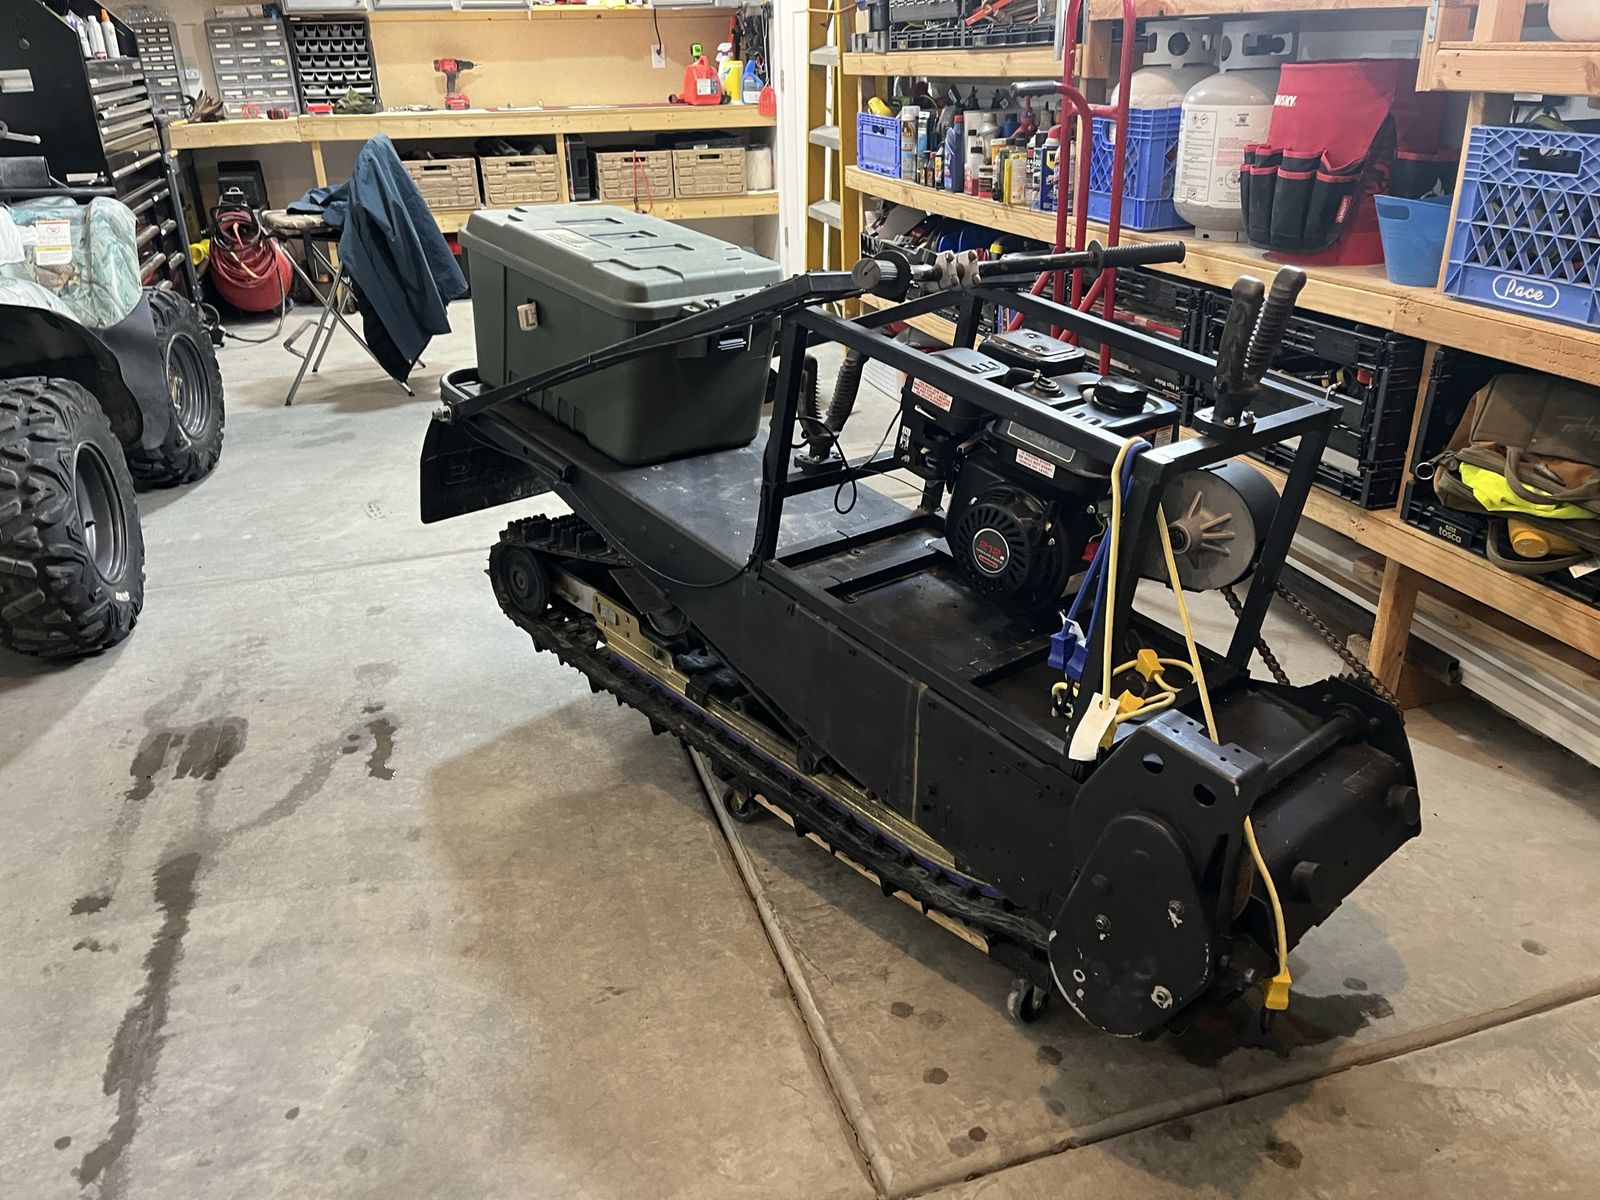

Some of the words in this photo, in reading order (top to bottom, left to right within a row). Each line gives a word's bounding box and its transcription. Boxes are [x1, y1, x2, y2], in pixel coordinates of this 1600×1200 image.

[1274, 94, 1297, 107] USKY
[1504, 278, 1544, 301] Pace
[1438, 526, 1462, 543] tosca
